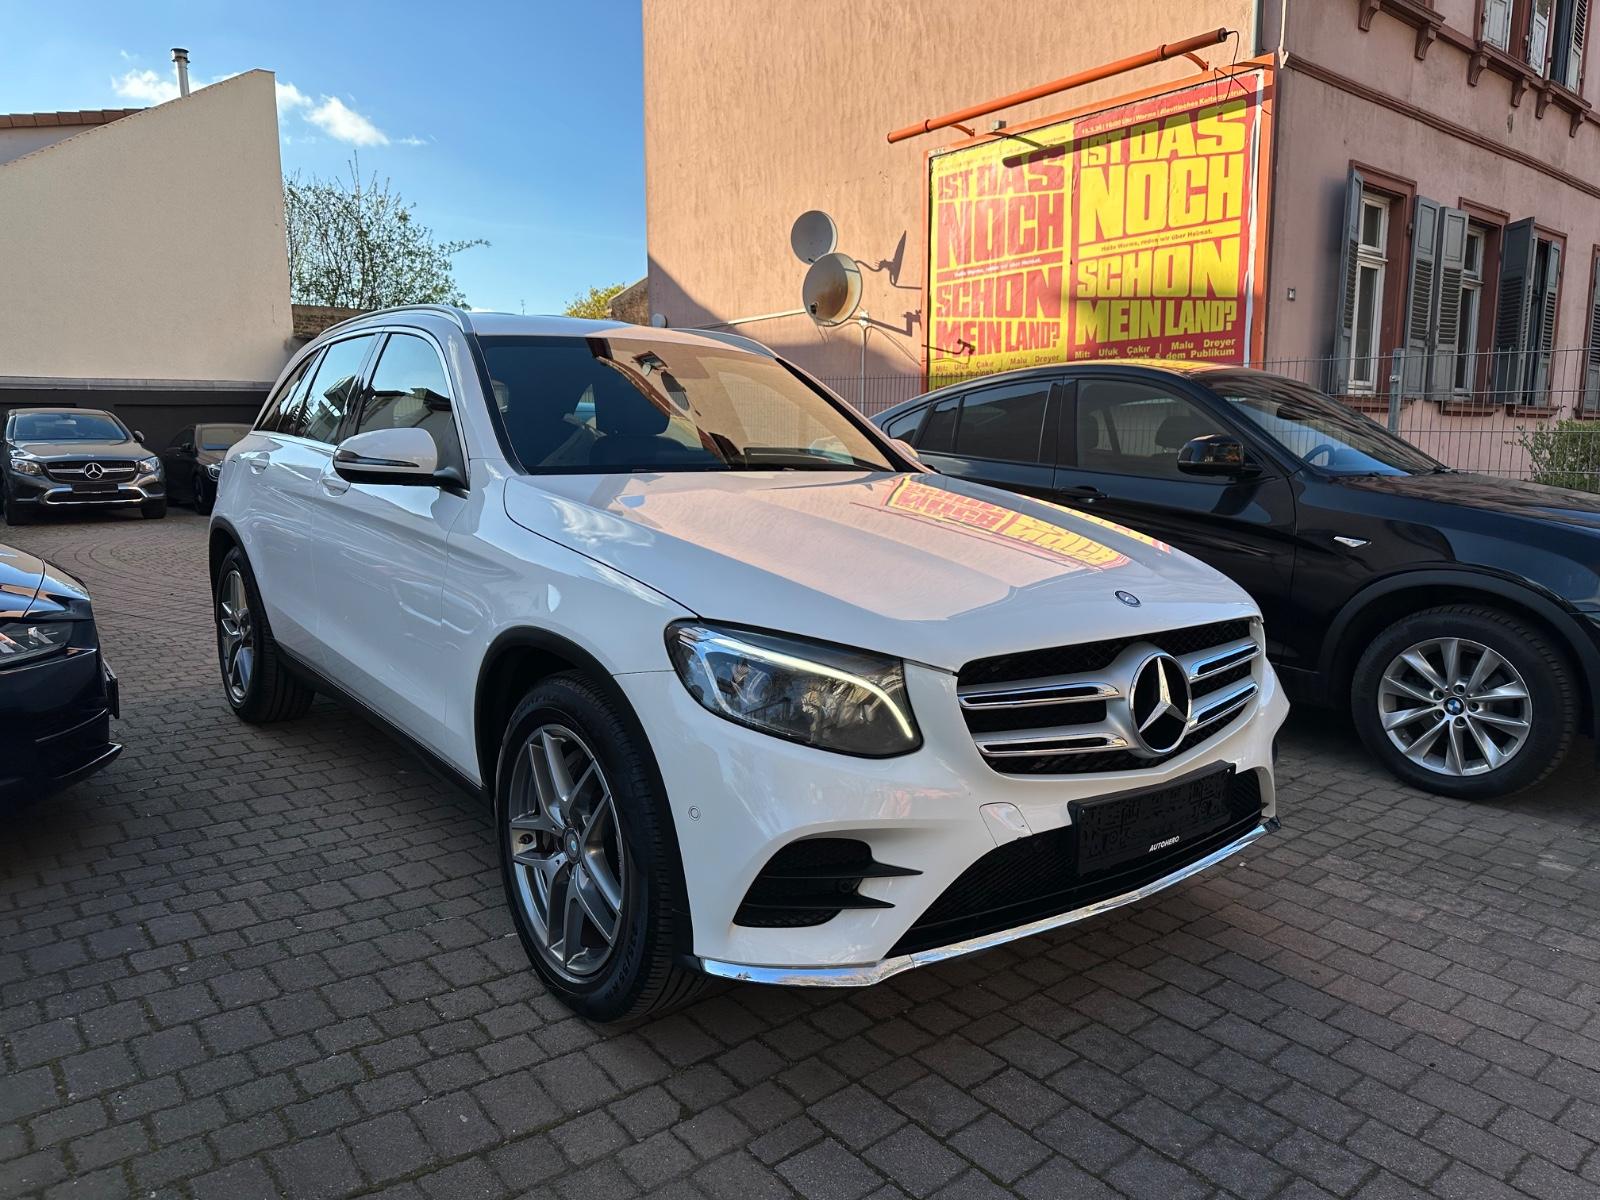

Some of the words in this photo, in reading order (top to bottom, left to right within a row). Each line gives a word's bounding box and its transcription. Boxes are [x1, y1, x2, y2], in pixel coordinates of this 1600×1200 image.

[1080, 128, 1126, 167] IST
[1129, 99, 1247, 161] DAS
[938, 168, 973, 198] IST
[976, 146, 1065, 197] DAS
[1078, 153, 1245, 244] NOCH
[937, 192, 1063, 269] NOCH
[936, 266, 1062, 318] SCHON
[1077, 236, 1240, 298] SCHON
[936, 321, 1001, 360] MEIN
[1005, 321, 1061, 352] LAND?
[1074, 299, 1161, 346] MEIN
[1164, 300, 1237, 337] LAND?
[1171, 341, 1194, 351] Malu
[1203, 338, 1236, 349] Dreyer
[1190, 347, 1235, 358] Publikum
[1149, 835, 1180, 852] AUTOHERO
